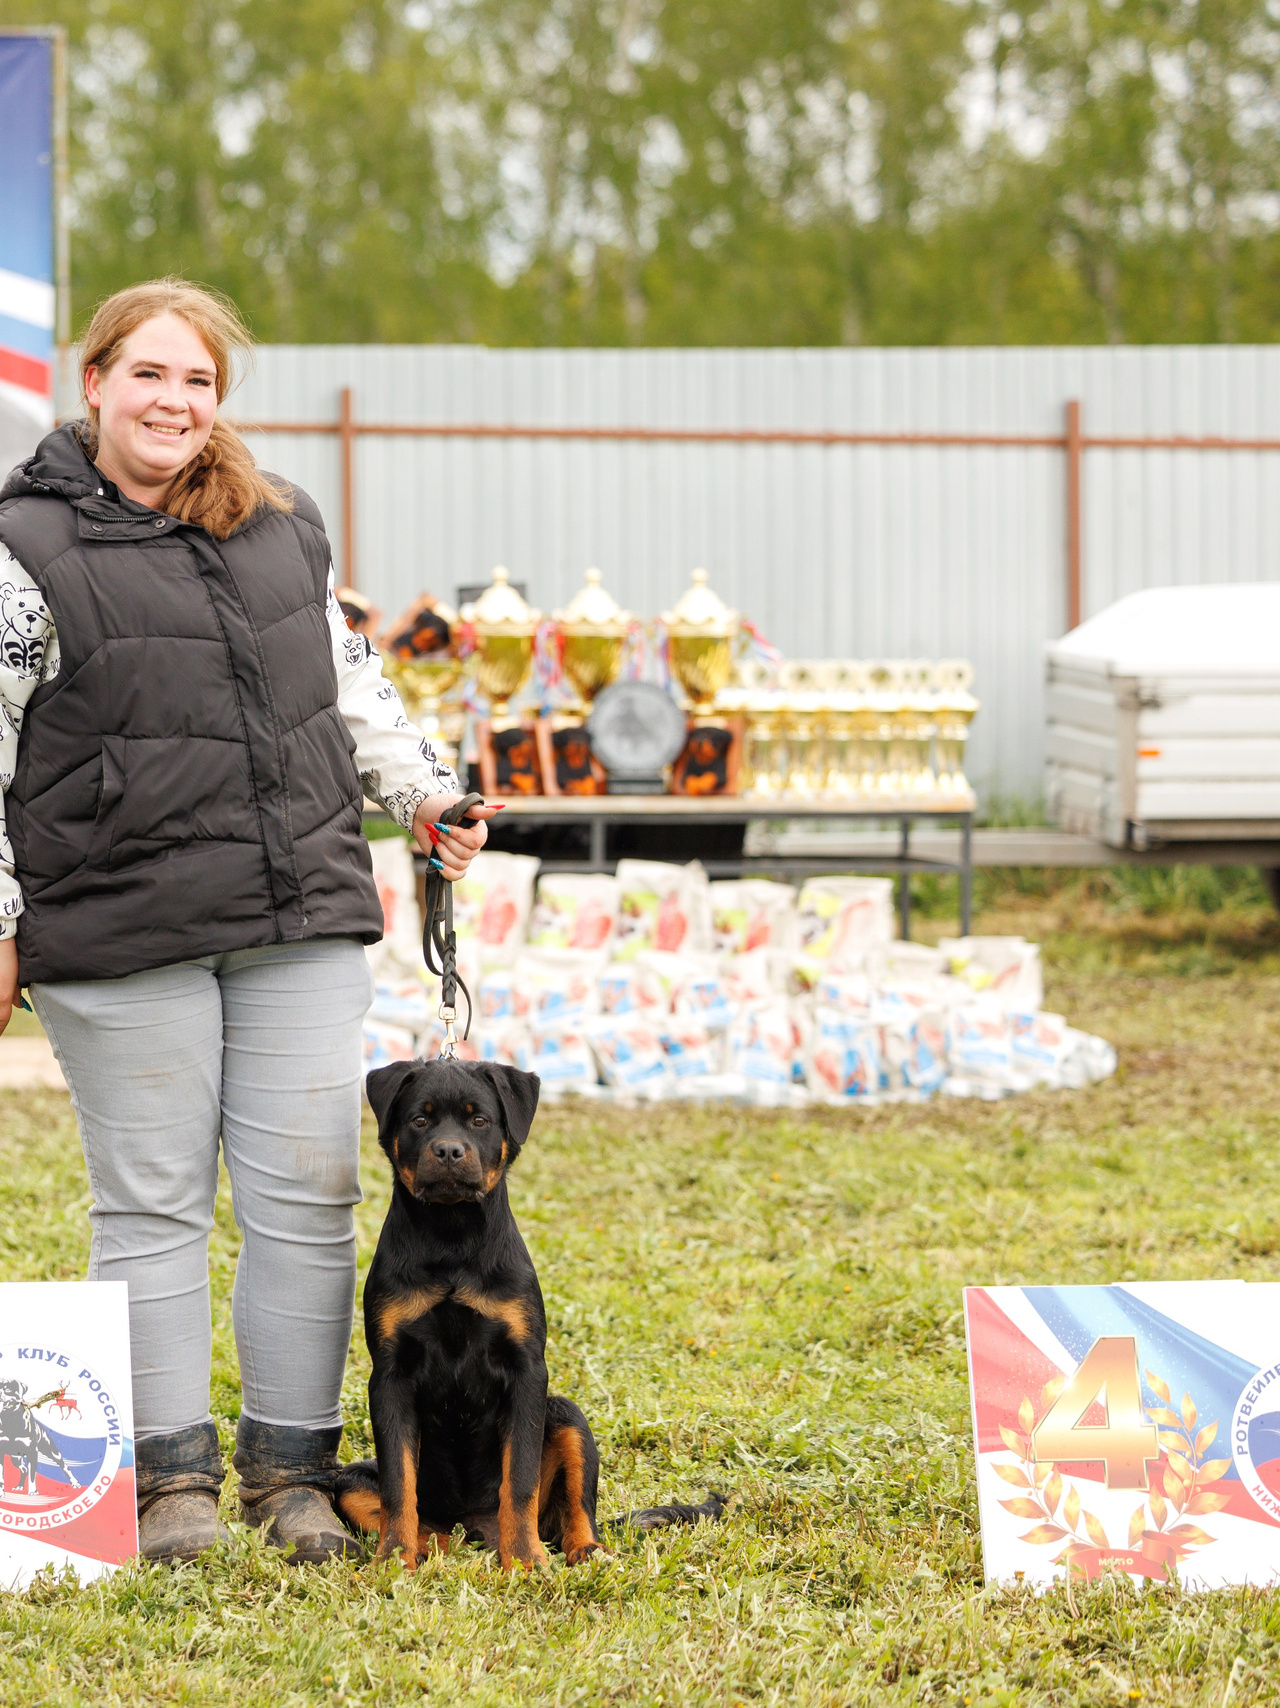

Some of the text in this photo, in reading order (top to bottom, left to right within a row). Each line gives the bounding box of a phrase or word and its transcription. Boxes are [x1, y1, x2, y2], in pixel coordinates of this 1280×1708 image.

[17, 1347, 70, 1369] КЛУБ
[78, 1368, 121, 1446] РОССИИ
[1032, 1335, 1161, 1491] 4
[93, 1474, 112, 1496] РО
